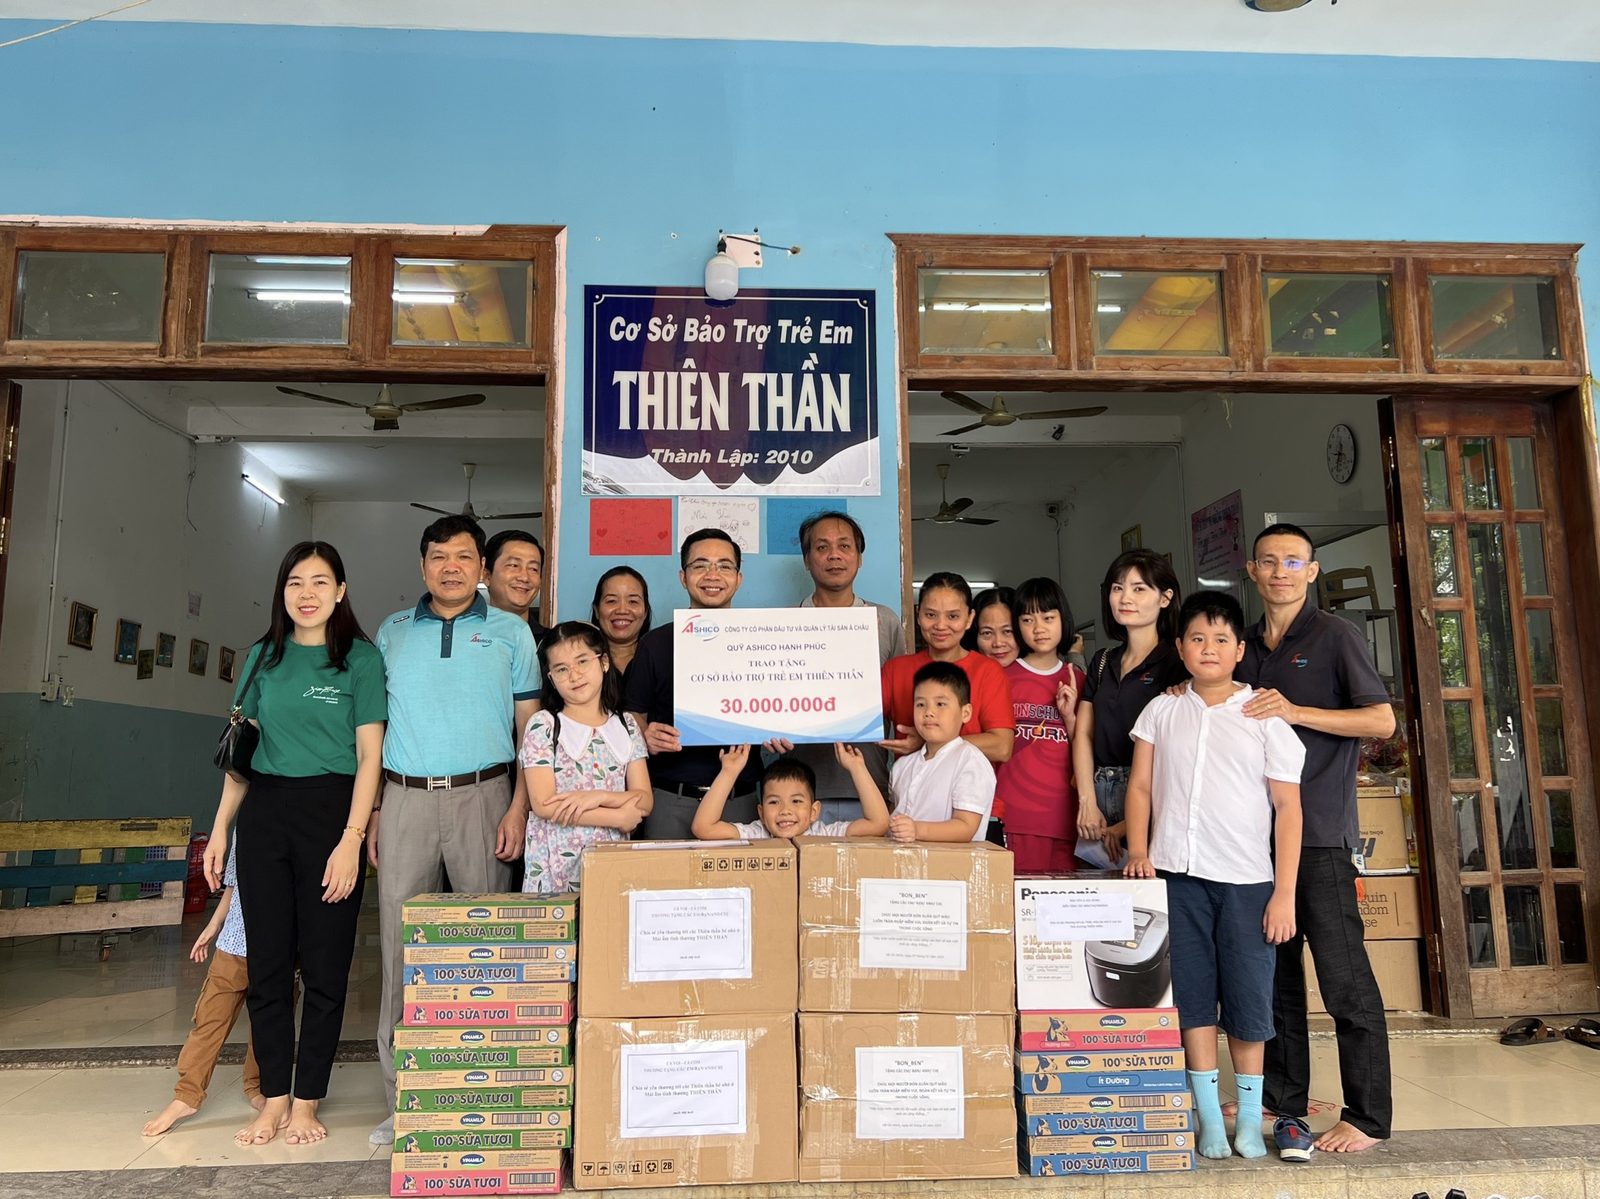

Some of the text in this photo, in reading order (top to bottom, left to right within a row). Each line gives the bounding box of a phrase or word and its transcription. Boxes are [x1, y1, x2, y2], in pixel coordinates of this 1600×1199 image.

[609, 314, 853, 350] Cơ Sở Bảo Trợ Trẻ Em
[612, 352, 851, 432] THIÊN THẦN
[651, 448, 813, 468] Thành Lập: 2010
[682, 621, 720, 633] ASHICO
[779, 644, 802, 652] HẠNH
[804, 642, 827, 650] PHÚC
[778, 658, 806, 668] TẶNG
[690, 673, 704, 682] CƠ
[789, 672, 803, 681] EM
[806, 670, 834, 680] THIÊN
[720, 697, 836, 713] 30.000.000đ
[464, 924, 485, 937] SỮA
[489, 925, 516, 936] TƯƠI
[461, 966, 484, 979] SỮA
[487, 967, 516, 978] TƯƠI
[459, 1007, 480, 1019] SỮA
[483, 1008, 509, 1019] TƯƠI
[1102, 1033, 1121, 1043] SỮA
[1124, 1034, 1146, 1043] TƯƠI
[456, 1050, 478, 1062] SỮA
[481, 1051, 509, 1062] TƯƠI
[1126, 1055, 1147, 1067] SỮA
[1149, 1055, 1174, 1066] TƯƠI
[1105, 1076, 1130, 1086] Đường
[460, 1092, 483, 1104] SỮA
[485, 1093, 513, 1103] TƯƠI
[1083, 1116, 1107, 1129] SỮA
[1109, 1117, 1137, 1128] TƯƠI
[458, 1133, 482, 1145] SỮA
[484, 1134, 512, 1145] TƯƠI
[1087, 1157, 1110, 1170] SỮA
[1112, 1157, 1140, 1168] TƯƠI
[449, 1176, 471, 1189] SỮA
[473, 1177, 501, 1188] TƯƠI
